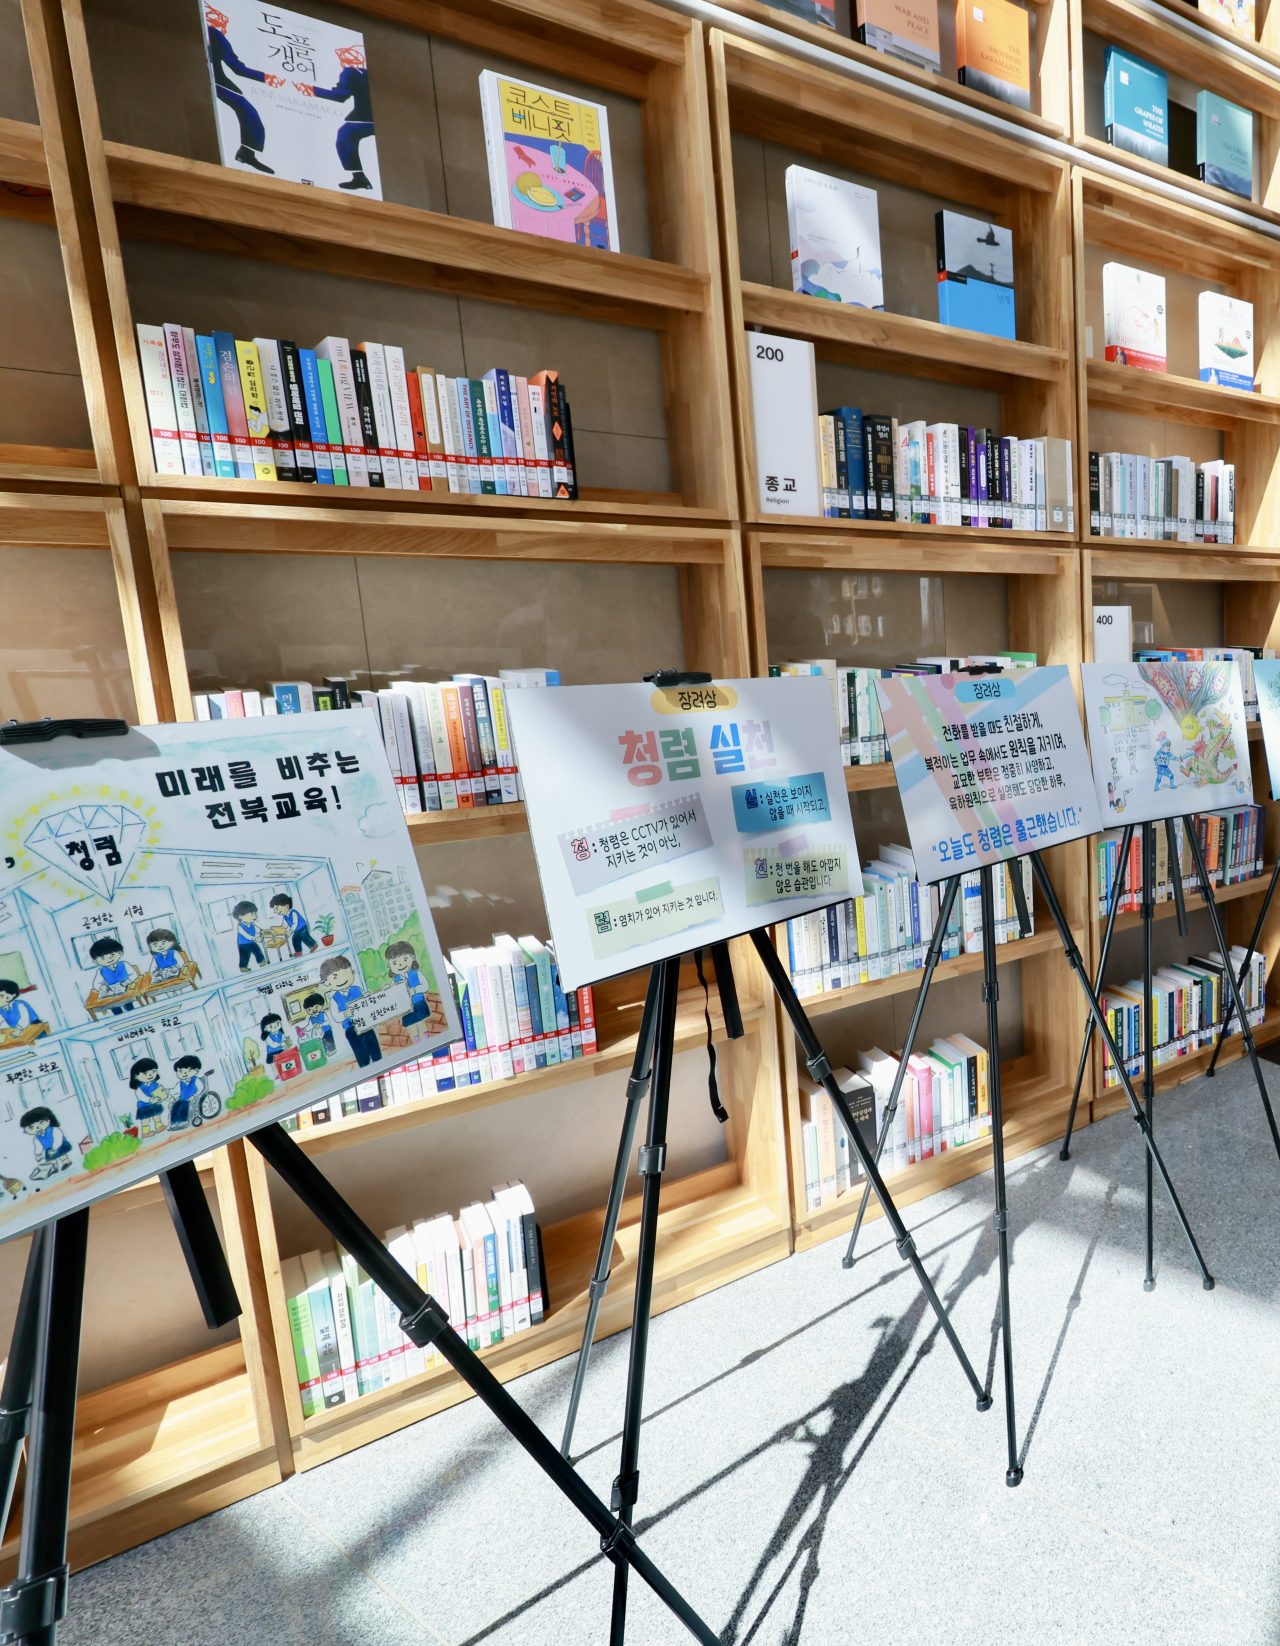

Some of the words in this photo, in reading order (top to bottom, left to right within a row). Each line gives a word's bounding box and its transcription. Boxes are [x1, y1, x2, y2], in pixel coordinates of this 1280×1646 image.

[906, 20, 930, 35] PEACE
[912, 12, 930, 24] AND
[506, 86, 574, 122] 코스트
[511, 108, 572, 142] 베니핏
[756, 345, 784, 362] 200
[465, 410, 470, 418] OF
[765, 475, 797, 492] 종교
[766, 497, 790, 505] Religion
[1096, 614, 1113, 626] 400
[678, 690, 717, 710] 장려상
[972, 682, 1002, 700] 장려상
[942, 724, 970, 742] 전화를
[970, 722, 988, 738] 받을
[988, 720, 1004, 734] 때도
[1004, 712, 1044, 733] 친절하게,
[618, 727, 702, 787] 청렴
[710, 720, 778, 775] 실천
[924, 754, 960, 773] 북적이는
[960, 751, 977, 768] 업무
[978, 745, 1009, 764] 속에서도
[1008, 738, 1037, 757] 원칙을
[1037, 732, 1068, 754] 지키며,
[156, 760, 257, 799] 미래를
[276, 750, 360, 781] 비추는
[952, 773, 976, 790] 교묘한
[977, 767, 1002, 783] 부탁은
[1002, 762, 1024, 780] 정중히
[1025, 756, 1056, 774] 사양하고,
[765, 789, 788, 806] 실천은
[790, 786, 813, 800] 보이지
[949, 788, 997, 812] 육하원칙으로
[998, 782, 1028, 800] 설명해도
[1028, 778, 1049, 795] 당당한
[1049, 773, 1066, 789] 하루,
[205, 786, 343, 830] 전북교육!
[768, 808, 784, 822] 않을
[786, 804, 796, 817] 때
[796, 798, 828, 816] 시작되고,
[599, 831, 630, 854] 청렴은
[632, 817, 668, 842] CCTV가
[669, 810, 698, 830] 있어서
[978, 823, 1014, 850] 청렴은
[64, 834, 124, 872] 청렴
[606, 850, 636, 868] 지키는
[638, 844, 658, 860] 것이
[658, 834, 682, 854] 아닌,
[776, 860, 785, 876] 천
[786, 860, 802, 876] 번을
[802, 860, 819, 874] 해도
[820, 857, 842, 872] 아깝지
[776, 878, 792, 894] 않은
[794, 874, 833, 892] 습관입니다.
[81, 911, 114, 930] 공정한
[123, 904, 145, 918] 시험
[619, 910, 644, 929] 염치가
[644, 905, 661, 920] 있어
[662, 898, 684, 916] 지키는
[686, 896, 695, 912] 것
[695, 890, 719, 908] 입니다.
[354, 1000, 368, 1011] 우리
[368, 993, 386, 1004] 함께
[353, 1017, 366, 1028] 렴을
[370, 1003, 398, 1020] 실천해요!
[117, 1022, 156, 1043] 배려하는
[160, 1016, 182, 1029] 학교
[5, 1068, 34, 1084] 투명한
[39, 1061, 60, 1075] 학교
